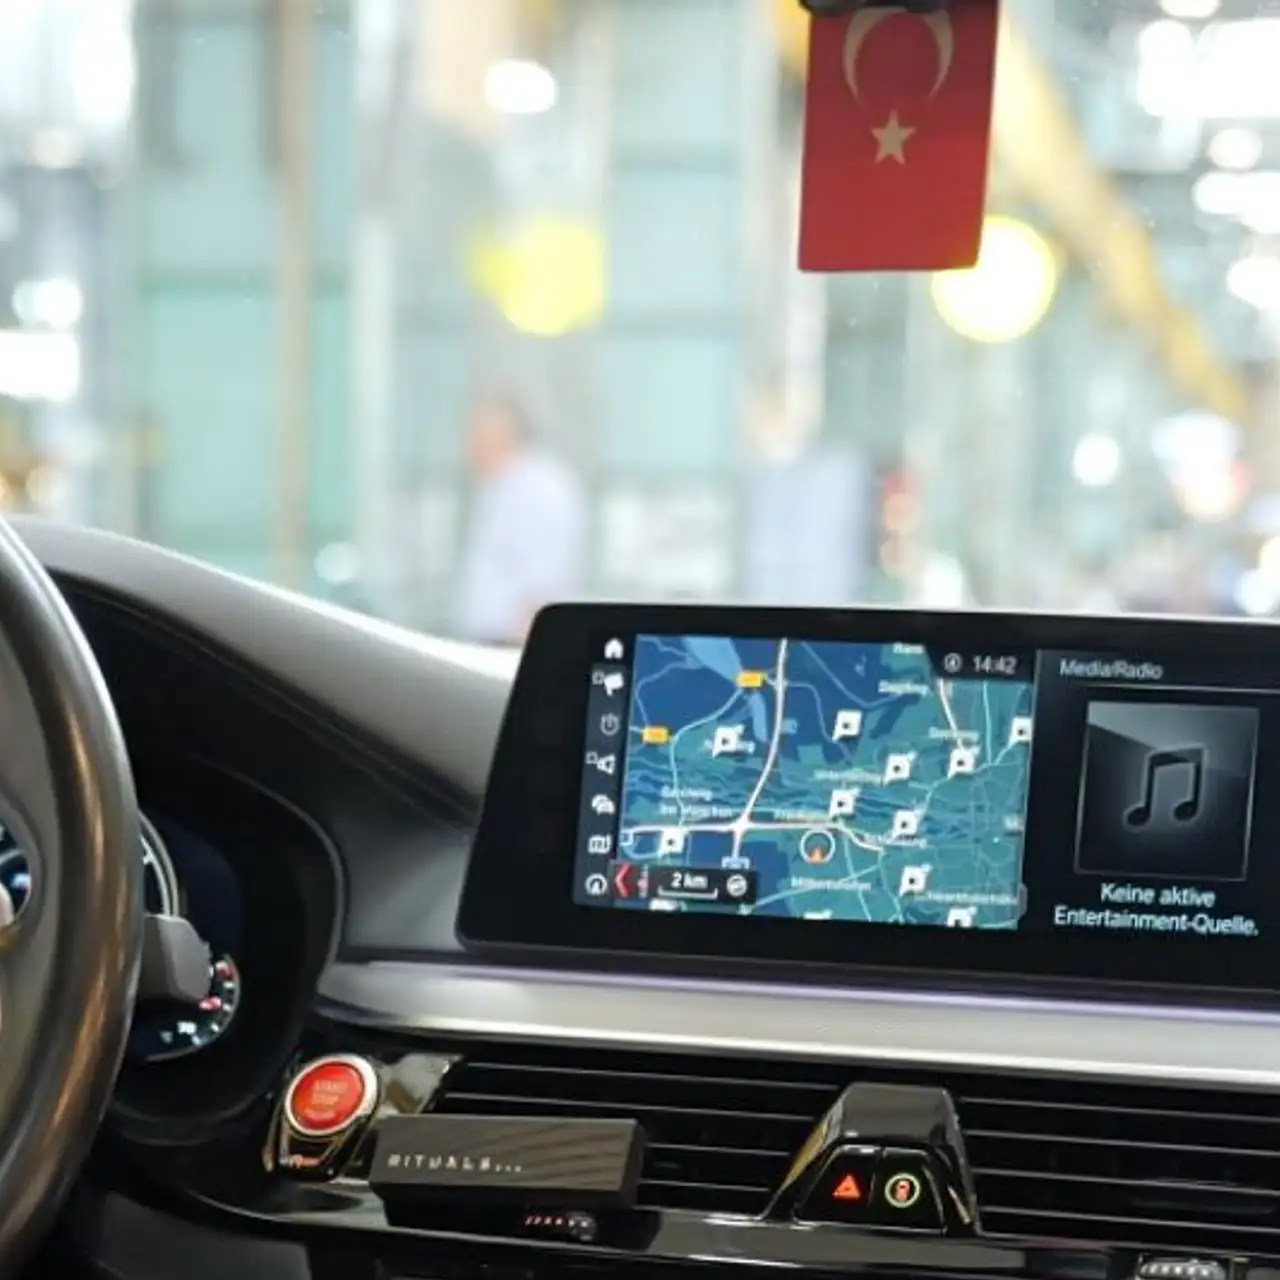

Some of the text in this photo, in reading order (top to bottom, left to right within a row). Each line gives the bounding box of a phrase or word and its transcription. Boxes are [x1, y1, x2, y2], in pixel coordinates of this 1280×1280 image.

[973, 655, 1018, 674] 14:42
[1059, 659, 1163, 679] Media/Radio
[671, 872, 708, 888] 2 km
[1100, 883, 1216, 908] Keine aktive
[1054, 907, 1259, 936] Entertainment-Quelle.
